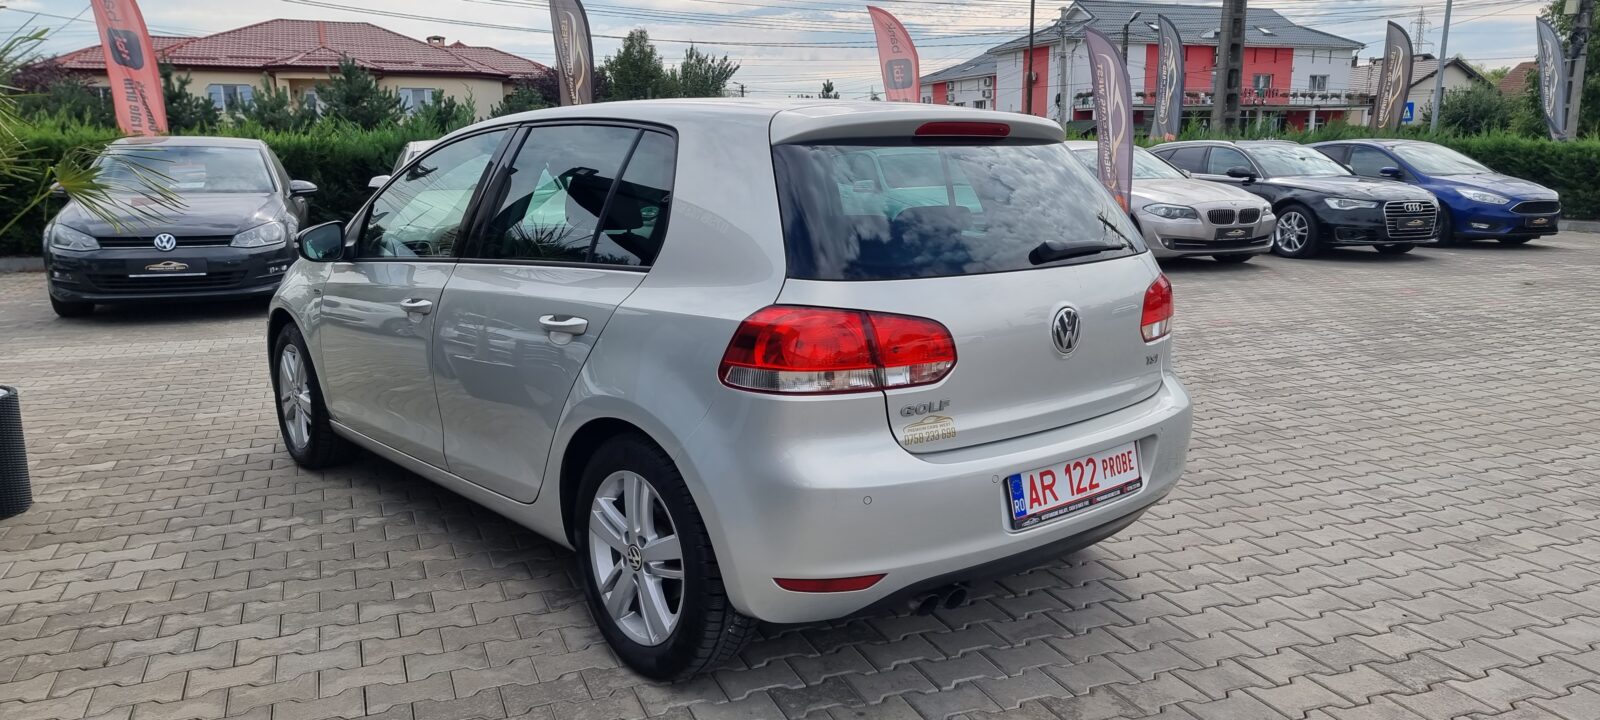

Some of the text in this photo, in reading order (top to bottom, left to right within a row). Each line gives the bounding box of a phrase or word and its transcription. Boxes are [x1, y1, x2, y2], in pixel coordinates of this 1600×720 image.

[900, 399, 951, 417] GOLF
[904, 432, 924, 446] 0758
[925, 430, 940, 442] 233
[1029, 450, 1135, 509] AR 122 PROBE
[1015, 498, 1025, 513] RO
